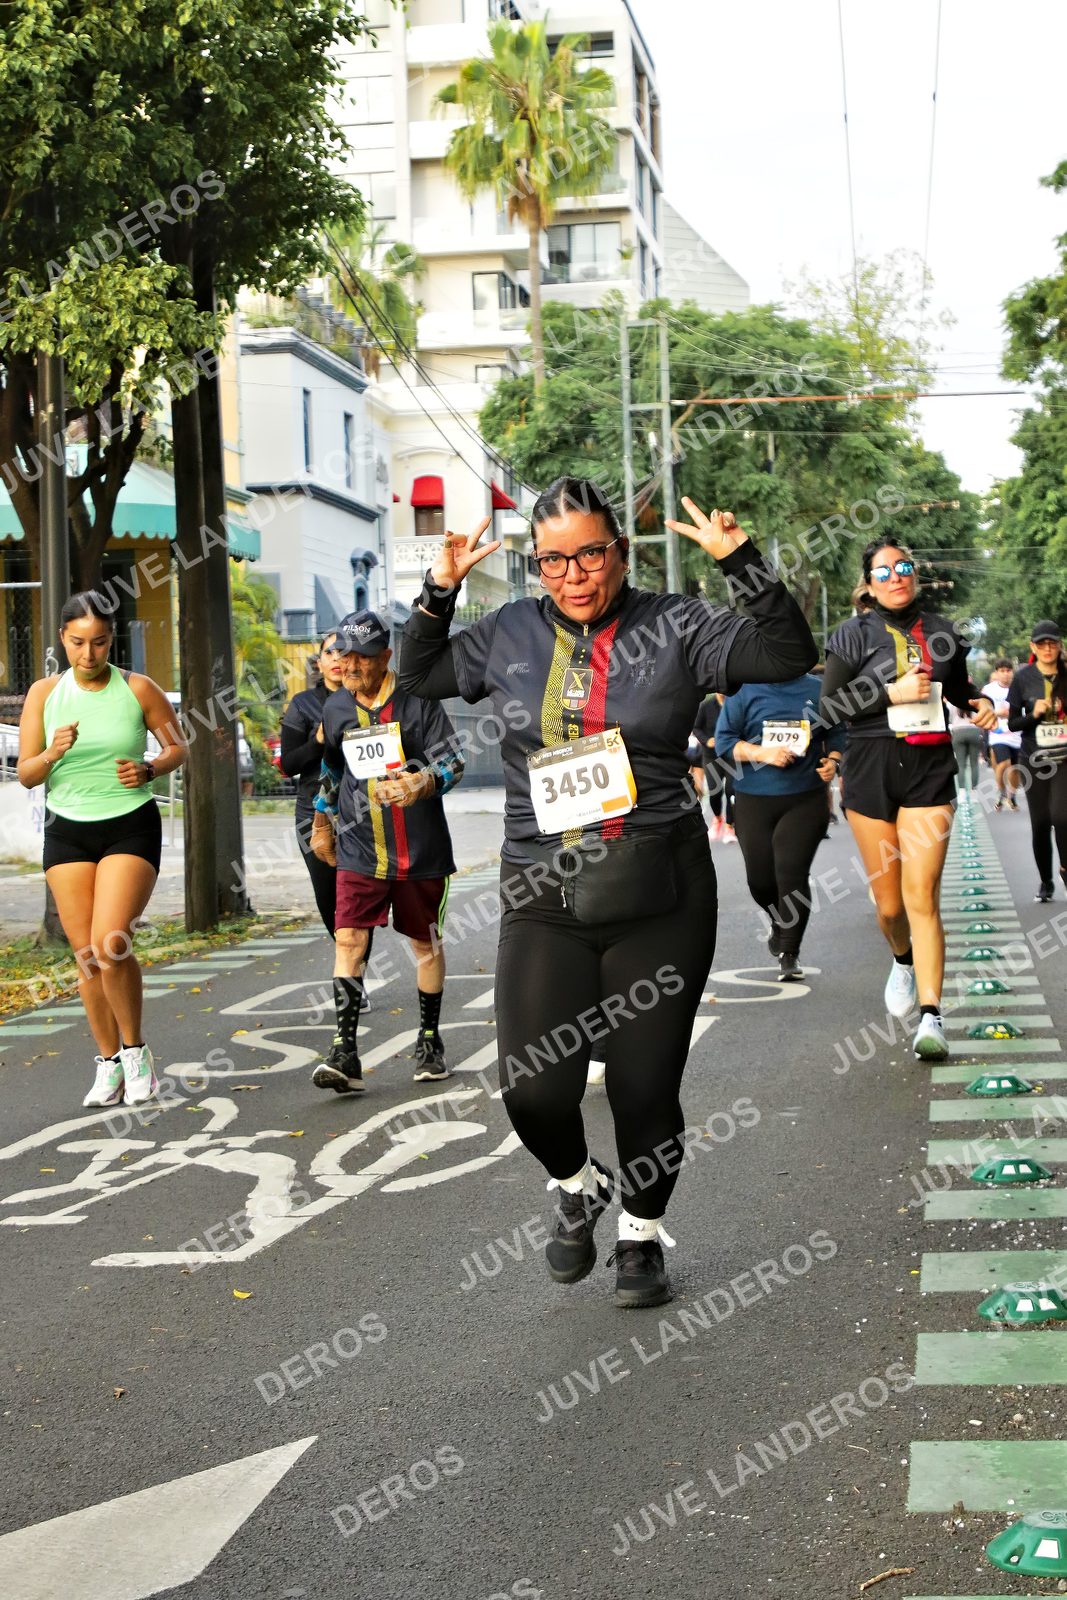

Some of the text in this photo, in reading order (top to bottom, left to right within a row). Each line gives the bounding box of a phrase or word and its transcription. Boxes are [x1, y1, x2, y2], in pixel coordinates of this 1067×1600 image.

[770, 732, 799, 742] 7079
[1041, 727, 1065, 737] 1473
[356, 742, 384, 761] 200
[541, 762, 610, 804] 3450
